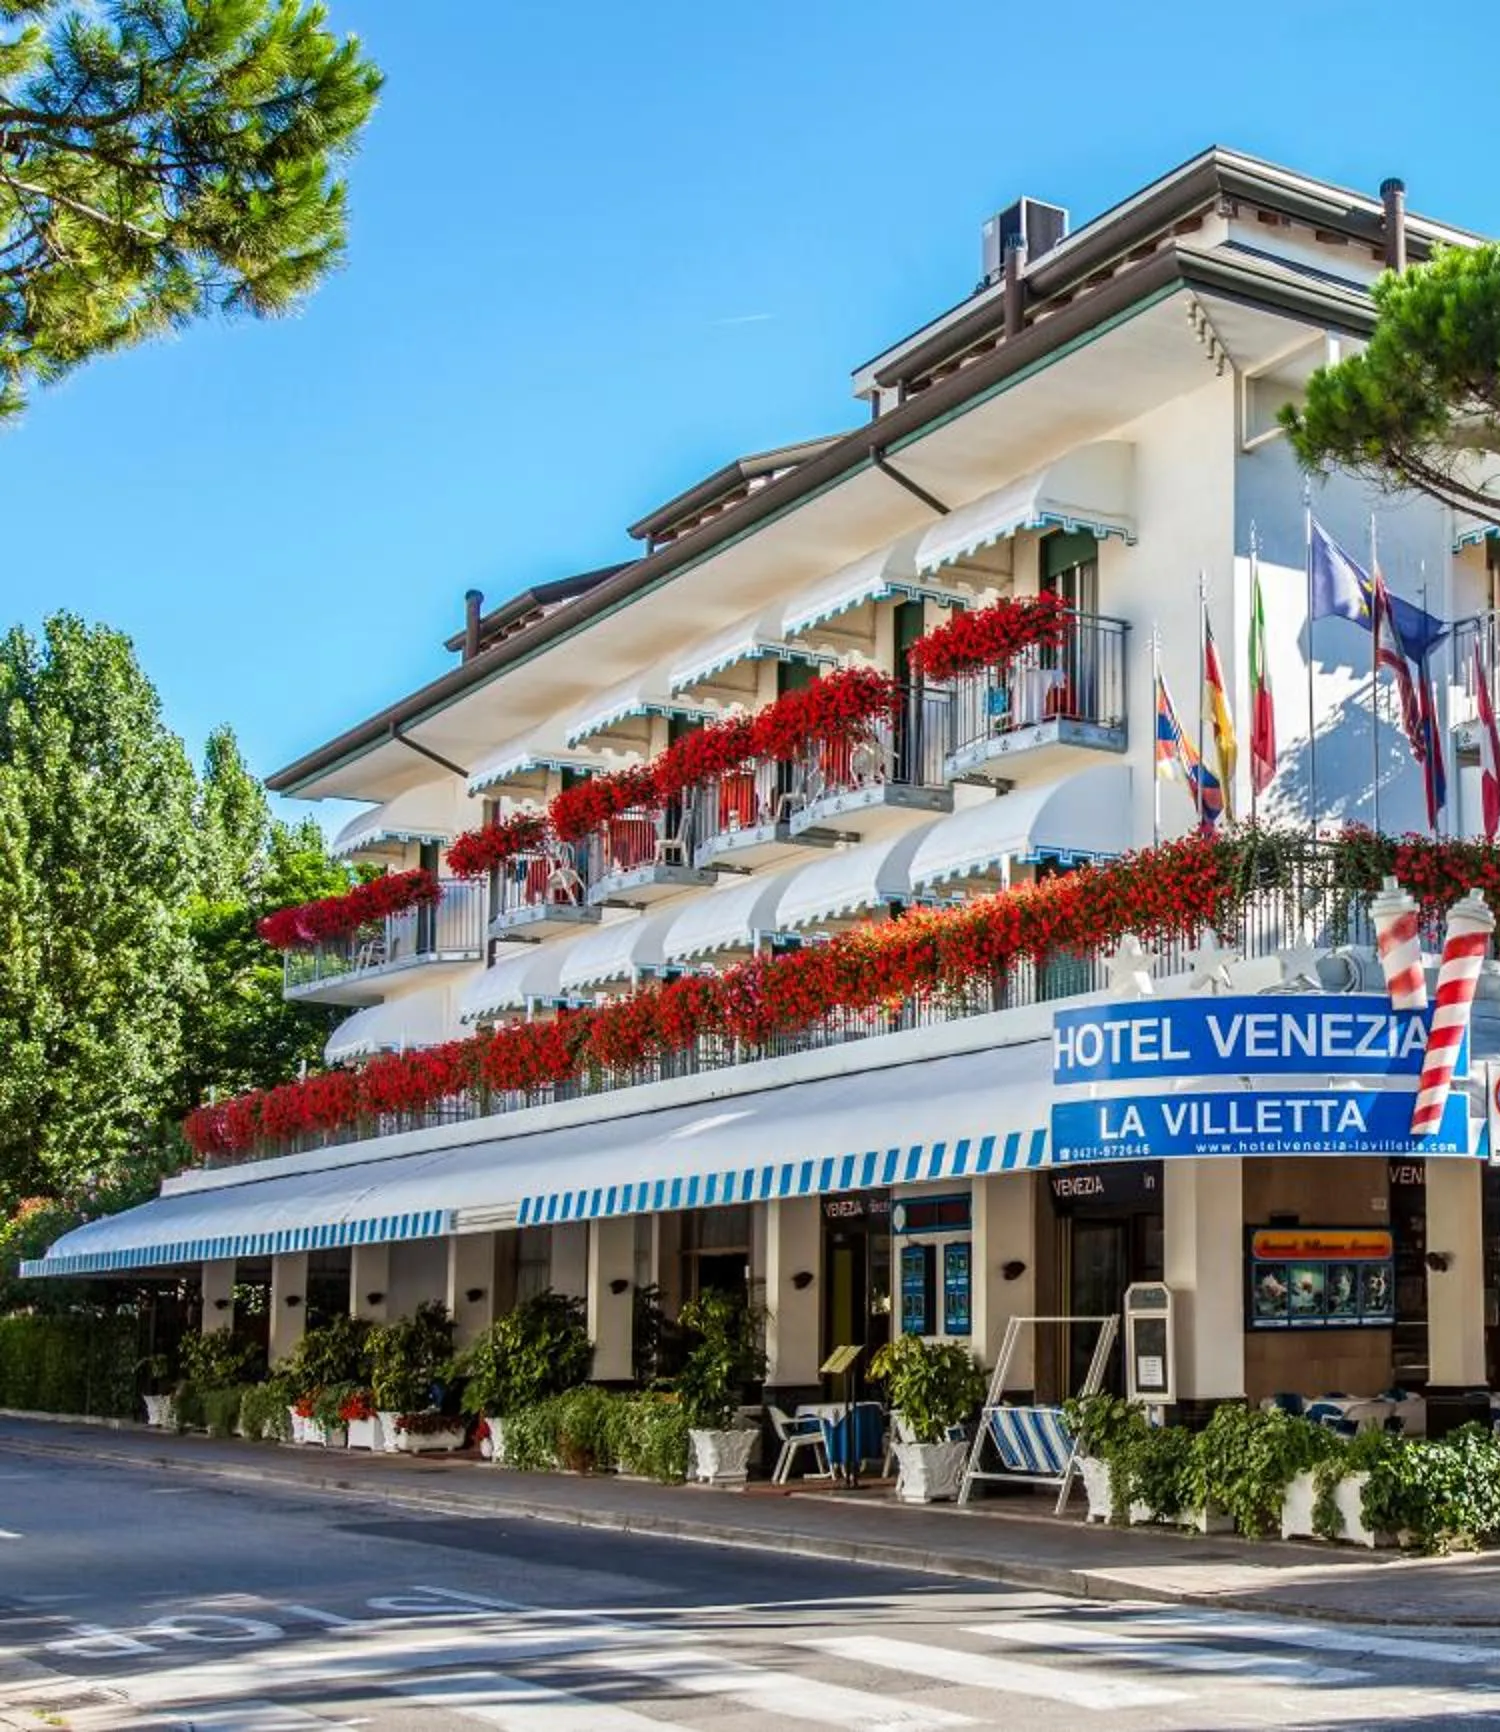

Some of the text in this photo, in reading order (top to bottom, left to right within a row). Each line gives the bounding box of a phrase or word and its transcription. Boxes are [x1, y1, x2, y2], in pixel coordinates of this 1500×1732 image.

[1053, 1012, 1430, 1071] HOTEL VENEZIA
[1100, 1098, 1367, 1140] LA VILLETTA
[1052, 1175, 1104, 1197] VENEZIA
[823, 1200, 864, 1217] VENEZIA
